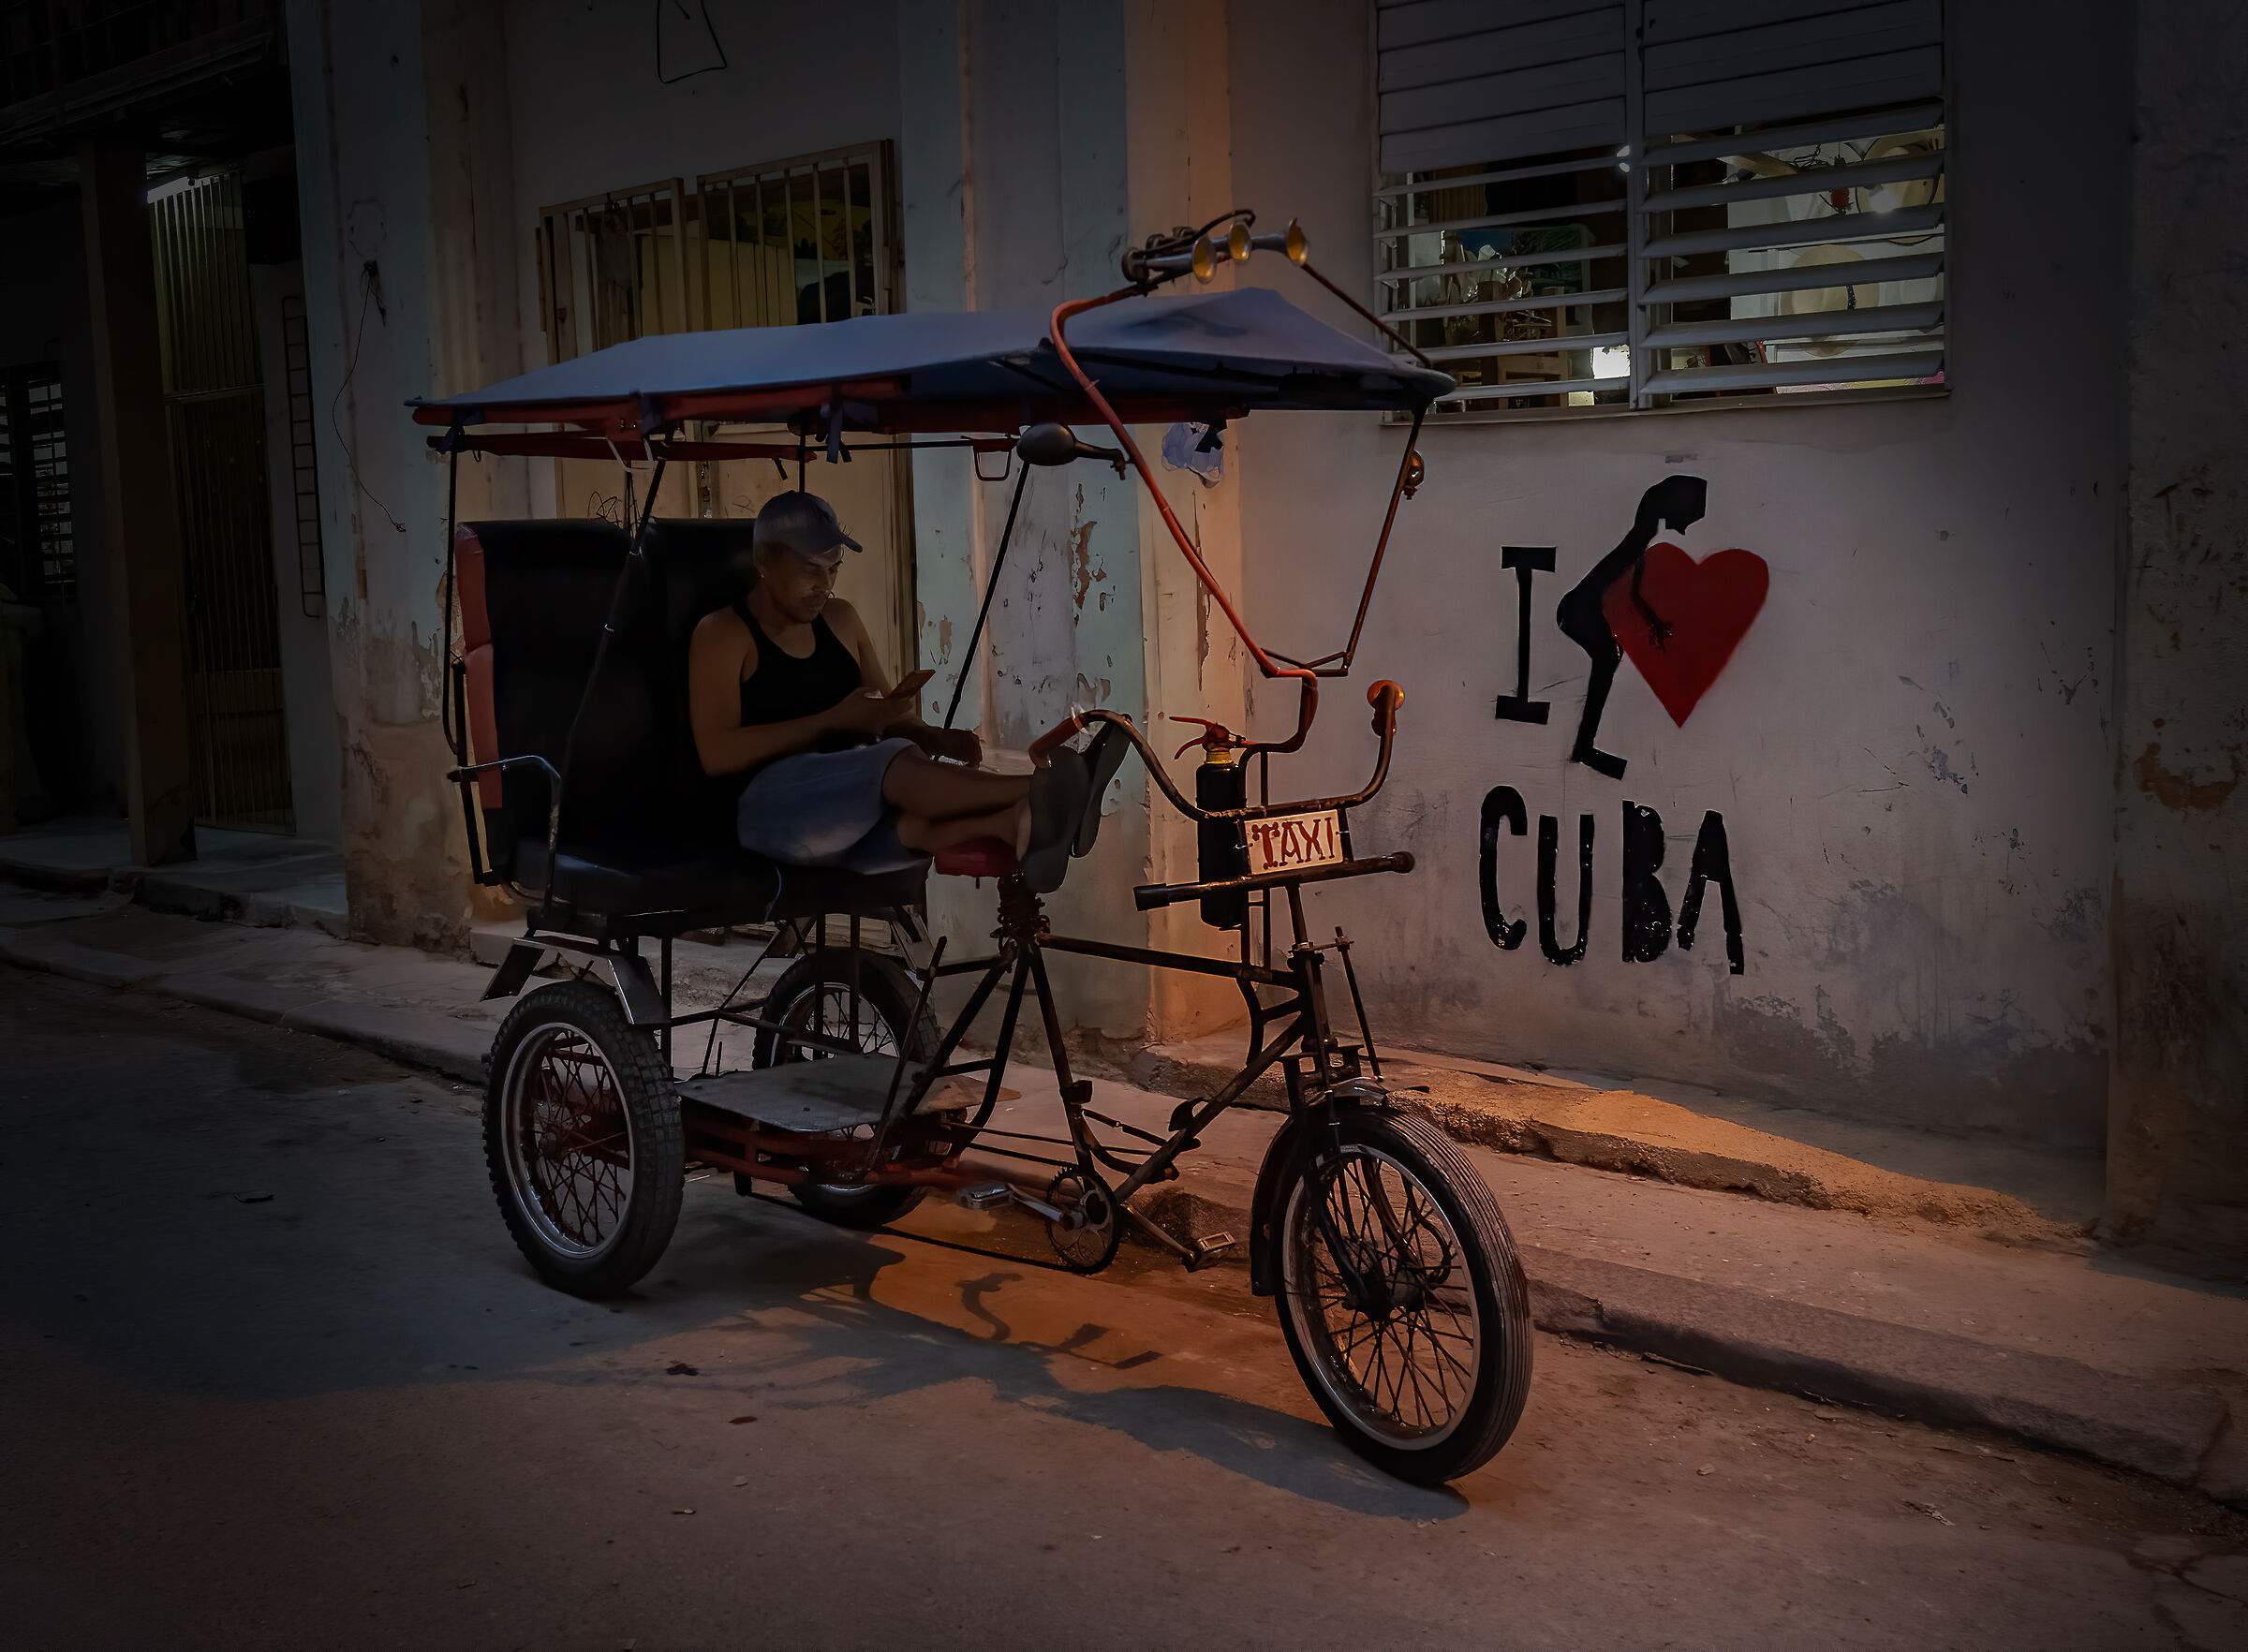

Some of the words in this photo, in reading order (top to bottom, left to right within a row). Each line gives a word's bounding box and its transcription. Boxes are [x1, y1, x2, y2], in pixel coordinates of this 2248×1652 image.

[1496, 547, 1556, 724] I
[1251, 817, 1336, 870] TAXI
[1480, 786, 1744, 974] CUBA
